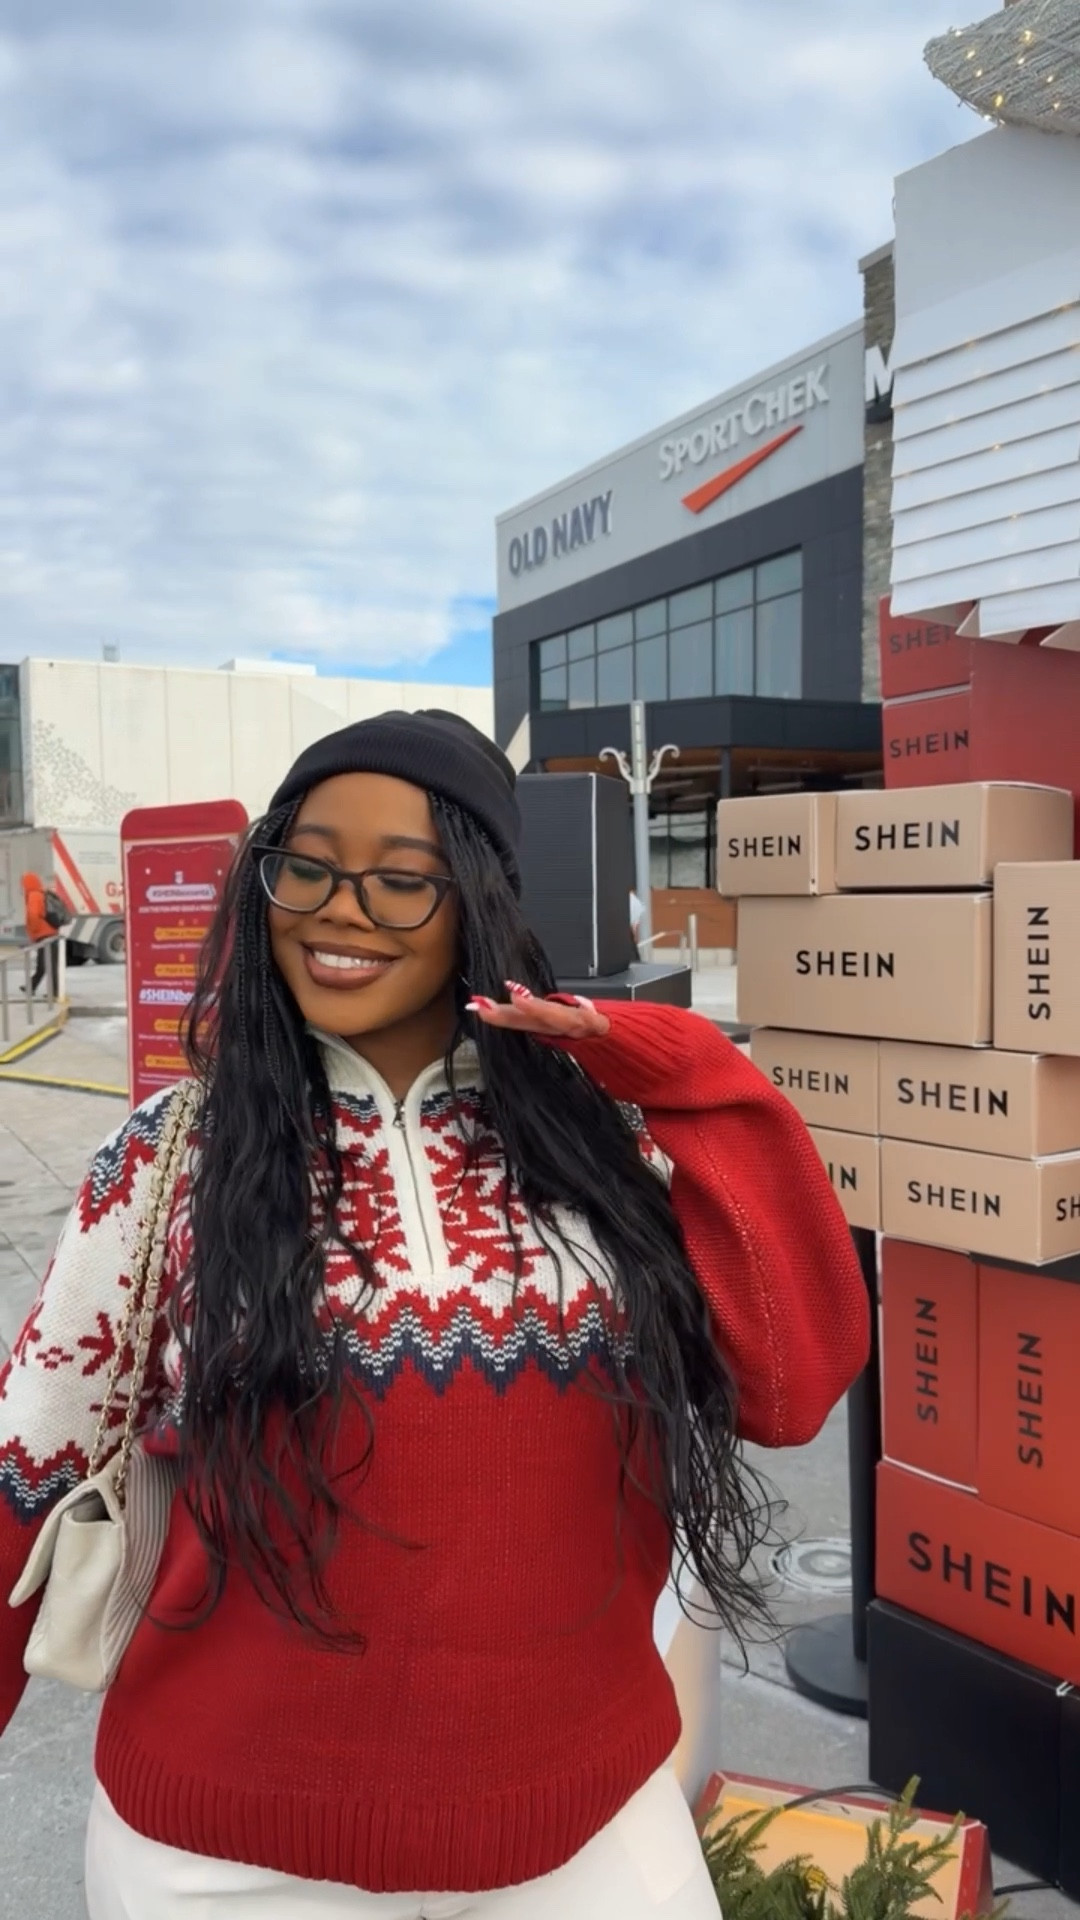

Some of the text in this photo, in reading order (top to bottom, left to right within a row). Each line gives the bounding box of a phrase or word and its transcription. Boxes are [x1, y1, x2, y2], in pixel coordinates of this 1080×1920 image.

[865, 345, 894, 402] M
[658, 363, 830, 482] SPORTCHEK
[508, 490, 613, 577] OLD NAVY
[889, 624, 953, 655] SHEI
[889, 729, 970, 759] SHEIN
[728, 834, 801, 858] SHEIN
[854, 819, 961, 852] SHEIN
[795, 949, 895, 979] SHEIN
[1027, 906, 1052, 1020] SHEIN
[772, 1065, 850, 1095] SHEIN
[897, 1077, 1009, 1117] SHEIN
[828, 1162, 857, 1191] IN
[907, 1180, 1001, 1218] SHEIN
[1056, 1195, 1080, 1222] SH
[914, 1297, 939, 1425] SHEIN
[1017, 1331, 1043, 1469] SHEIN
[907, 1530, 1076, 1636] SHEIN
